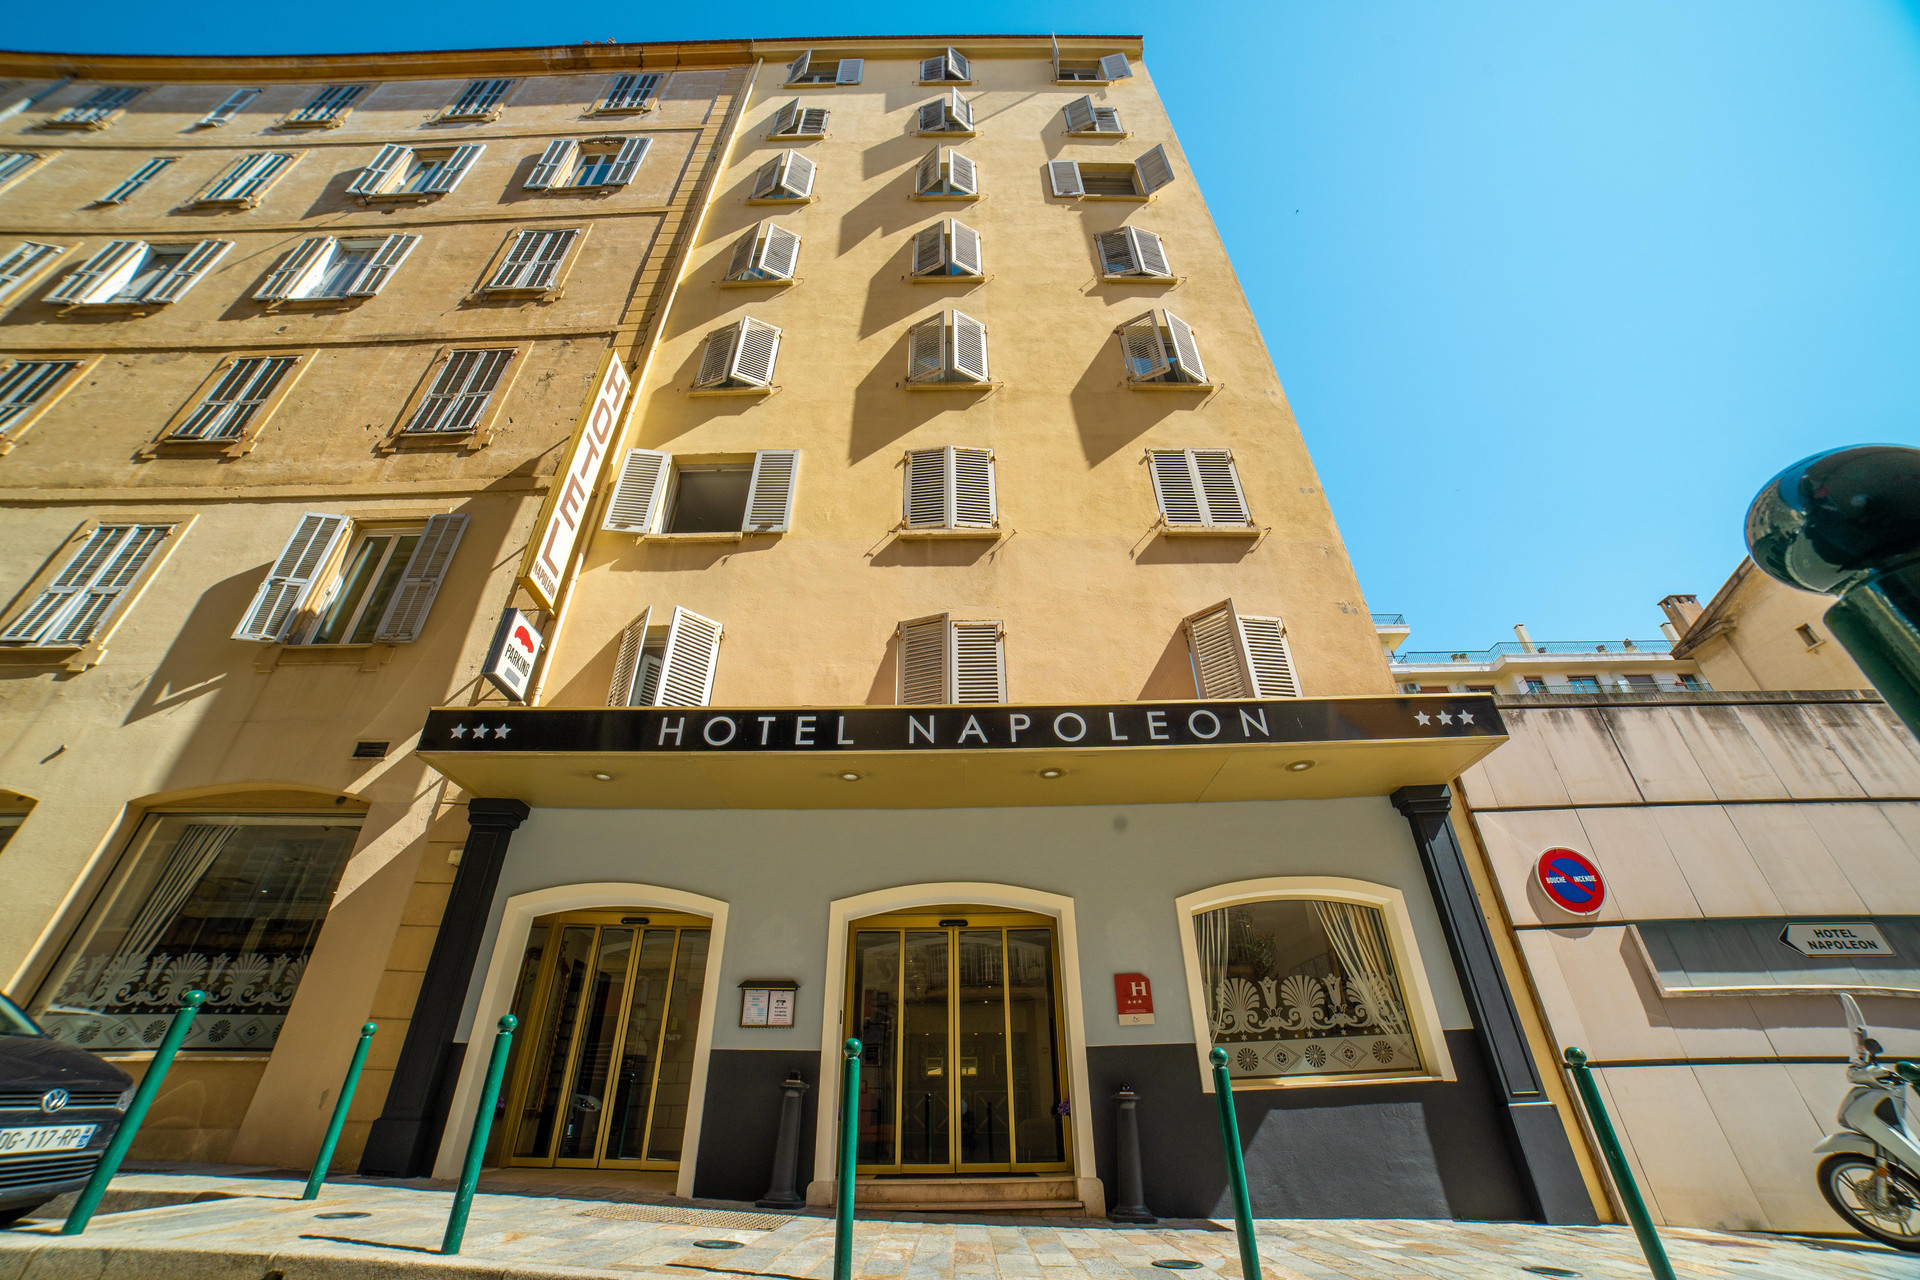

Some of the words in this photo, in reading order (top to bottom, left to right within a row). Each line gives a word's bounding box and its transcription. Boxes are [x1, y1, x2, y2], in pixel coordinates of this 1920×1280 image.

[542, 362, 627, 578] HOTEL
[532, 560, 556, 600] NAPOLEON
[504, 643, 531, 678] PARKING
[658, 716, 855, 746] HOTEL
[908, 711, 1270, 744] NAPOLEON
[1545, 876, 1567, 884] BOUCHE
[1573, 875, 1597, 883] INCENDIE
[1807, 940, 1879, 951] NAPOLEON
[1813, 928, 1858, 939] HOTEL
[1130, 981, 1148, 997] H
